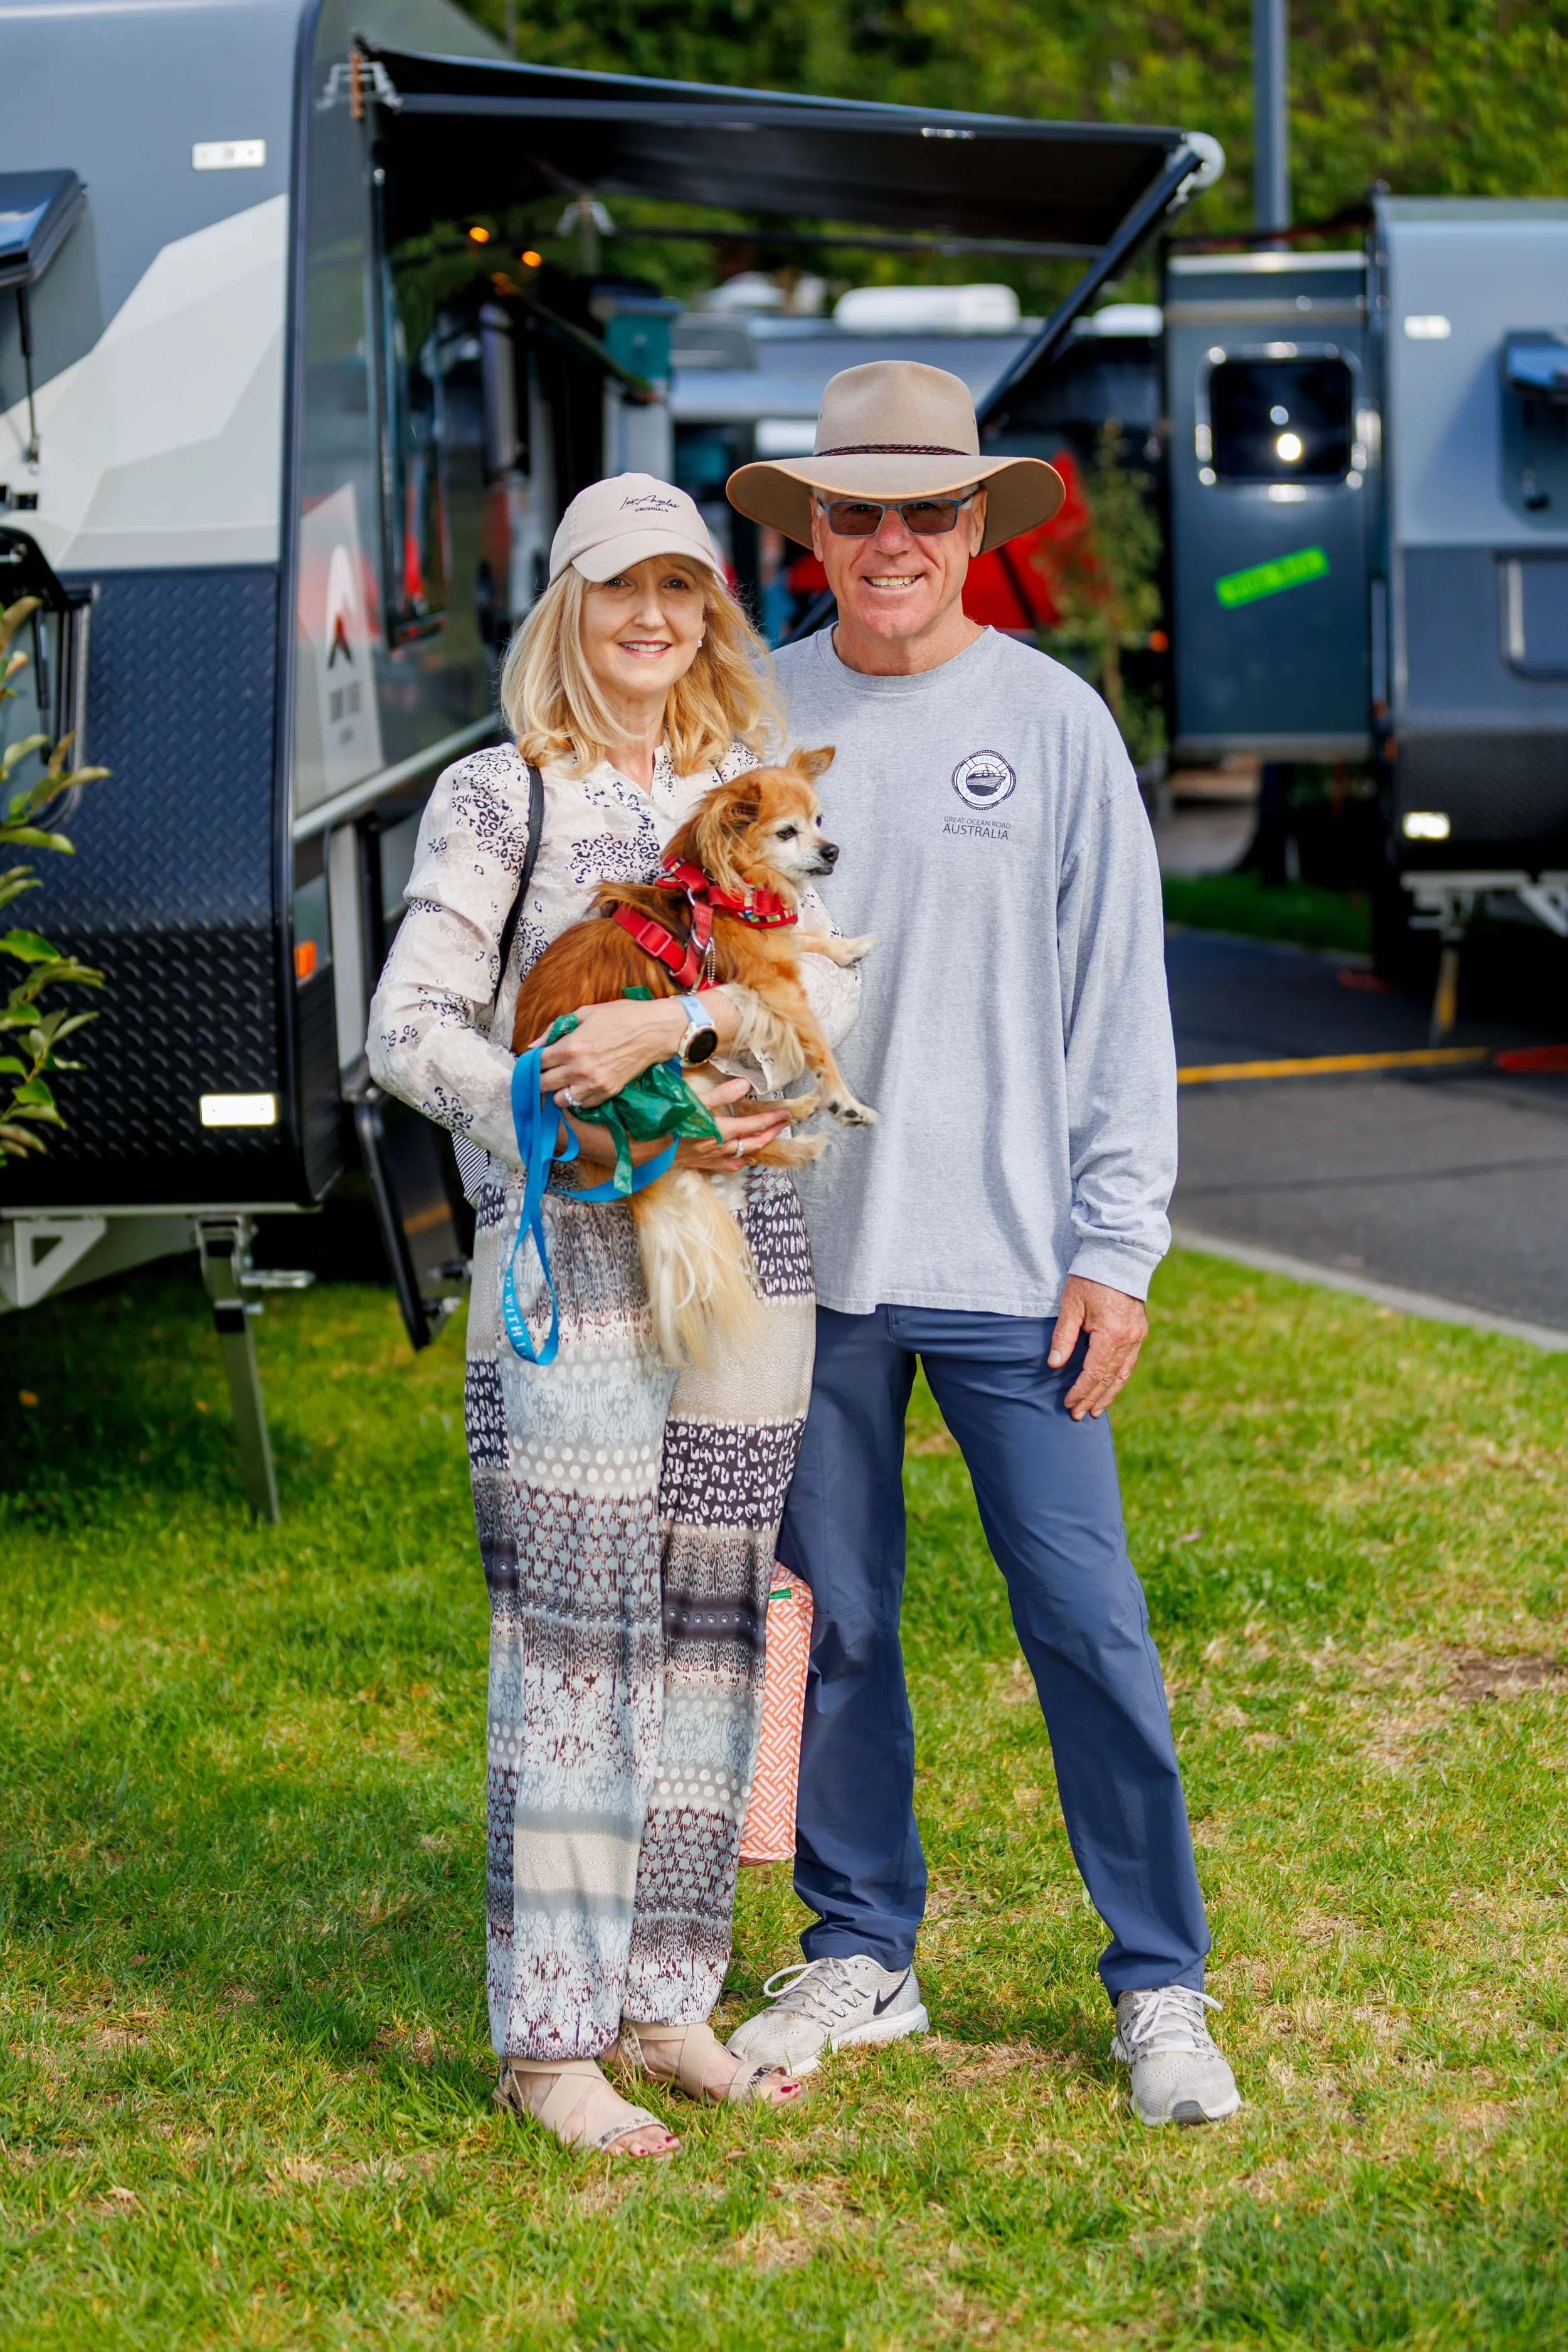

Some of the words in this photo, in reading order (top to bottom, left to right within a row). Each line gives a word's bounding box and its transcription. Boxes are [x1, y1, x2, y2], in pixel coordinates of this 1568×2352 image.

[637, 495, 680, 509] Angeles
[975, 757, 1000, 765] LORNE
[970, 795, 997, 803] ANGLING
[998, 782, 1009, 796] CLUB
[967, 818, 990, 827] OCEAN
[992, 821, 1011, 829] ROAD
[943, 824, 1009, 840] AUSTRALIA
[506, 1294, 524, 1337] WITH
